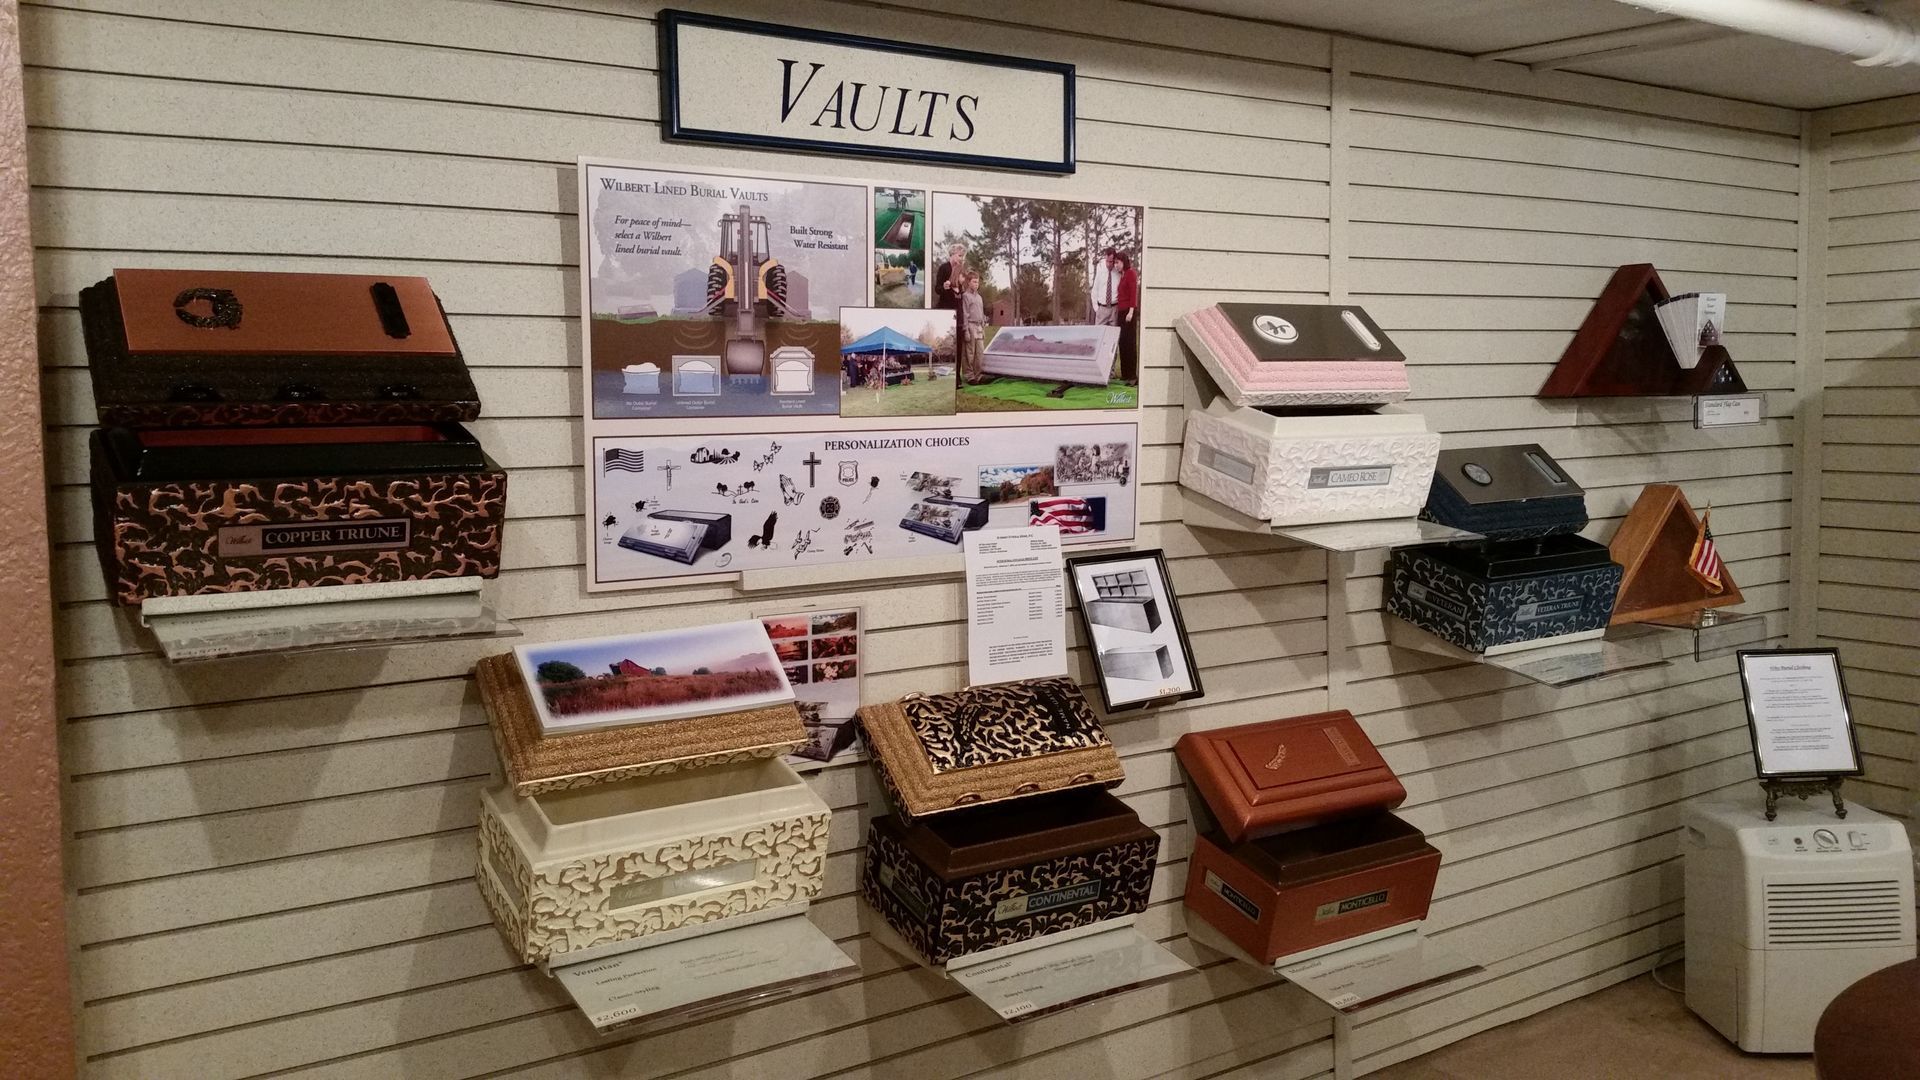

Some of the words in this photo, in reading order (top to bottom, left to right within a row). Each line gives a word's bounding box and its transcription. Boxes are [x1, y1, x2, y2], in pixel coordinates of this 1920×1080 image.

[777, 58, 979, 142] VAULTS
[600, 177, 650, 193] WILBERT
[654, 181, 687, 196] LINED
[690, 184, 728, 199] BURIAL
[730, 187, 769, 201] VAULTS
[614, 215, 628, 225] For
[629, 218, 651, 228] peace
[651, 218, 662, 229] of
[614, 231, 633, 240] select
[643, 231, 672, 242] Wilbert
[790, 226, 808, 236] Built
[809, 227, 833, 238] Strong
[615, 244, 635, 254] lined
[636, 244, 660, 256] burial
[794, 239, 816, 249] Water
[817, 240, 849, 250] Resistant
[824, 438, 922, 450] PERSONALIZATION
[925, 437, 970, 447] CHOICES
[1331, 472, 1360, 483] CAMEO
[1360, 472, 1377, 481] ROSE
[265, 529, 331, 544] COPPER
[336, 525, 401, 541] TRIUNE
[1431, 595, 1463, 615] VETERAN
[1536, 603, 1559, 613] VETERAN
[1028, 886, 1096, 908] CONTINENTAL
[1223, 888, 1256, 915] MONTICELLO
[1340, 893, 1385, 912] MONTICELLO
[597, 1007, 637, 1022] $2,600
